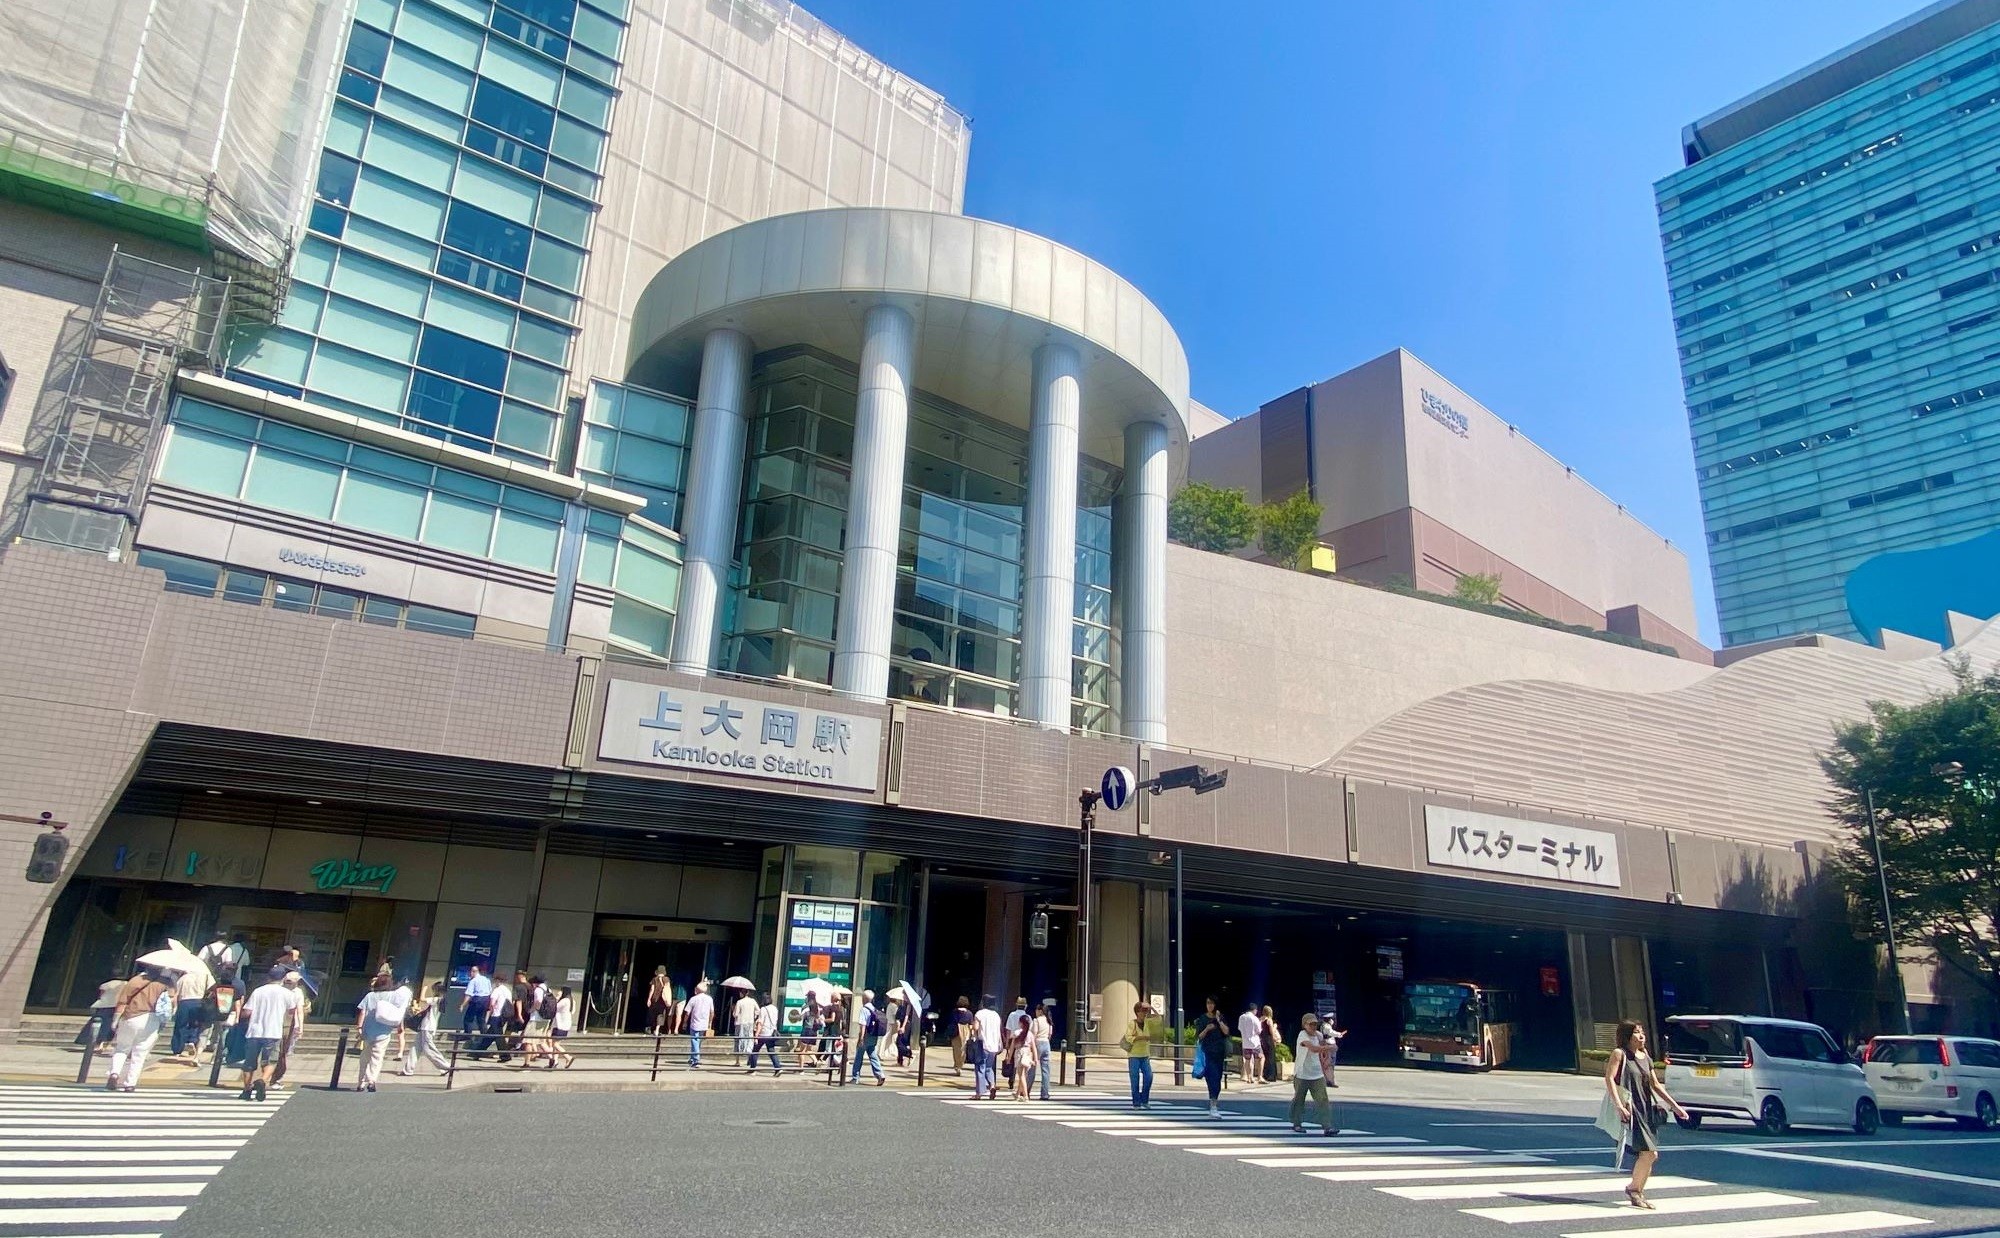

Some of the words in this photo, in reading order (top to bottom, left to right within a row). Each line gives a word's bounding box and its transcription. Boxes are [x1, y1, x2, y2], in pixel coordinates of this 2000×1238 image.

[639, 691, 852, 755] 上大岡駅
[652, 739, 757, 769] Kamiooka
[762, 755, 833, 779] Station
[1447, 826, 1604, 872] バスターミナル
[310, 859, 397, 893] Wing
